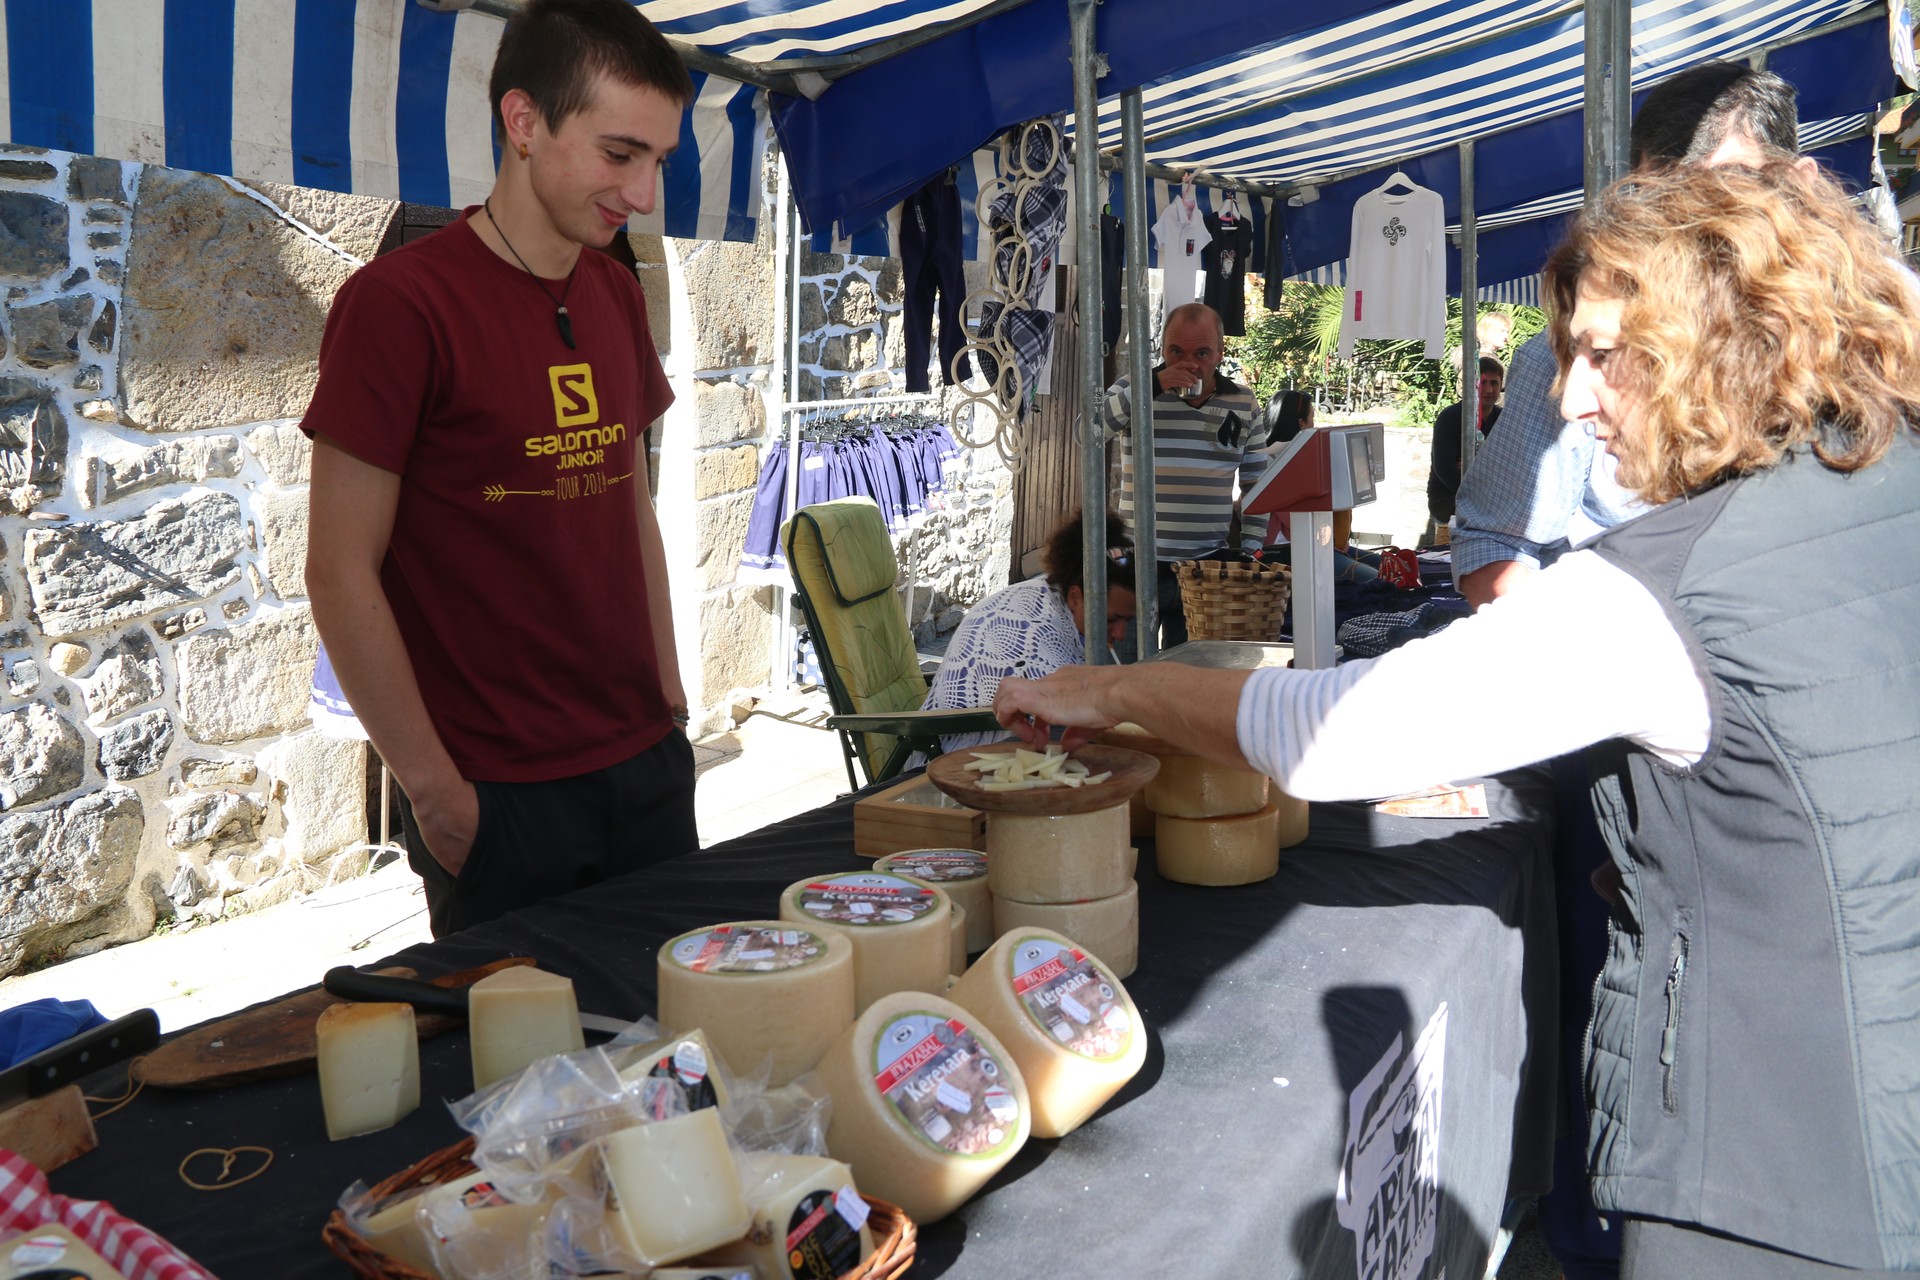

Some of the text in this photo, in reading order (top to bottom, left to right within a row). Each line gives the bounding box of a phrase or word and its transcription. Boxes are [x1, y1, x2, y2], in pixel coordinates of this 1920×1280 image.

[556, 449, 605, 470] JUNIOR
[556, 476, 580, 501] TOUR
[822, 891, 913, 903] Kerexara
[1033, 972, 1091, 1009] Kerexara
[903, 1048, 972, 1103] Kerexara
